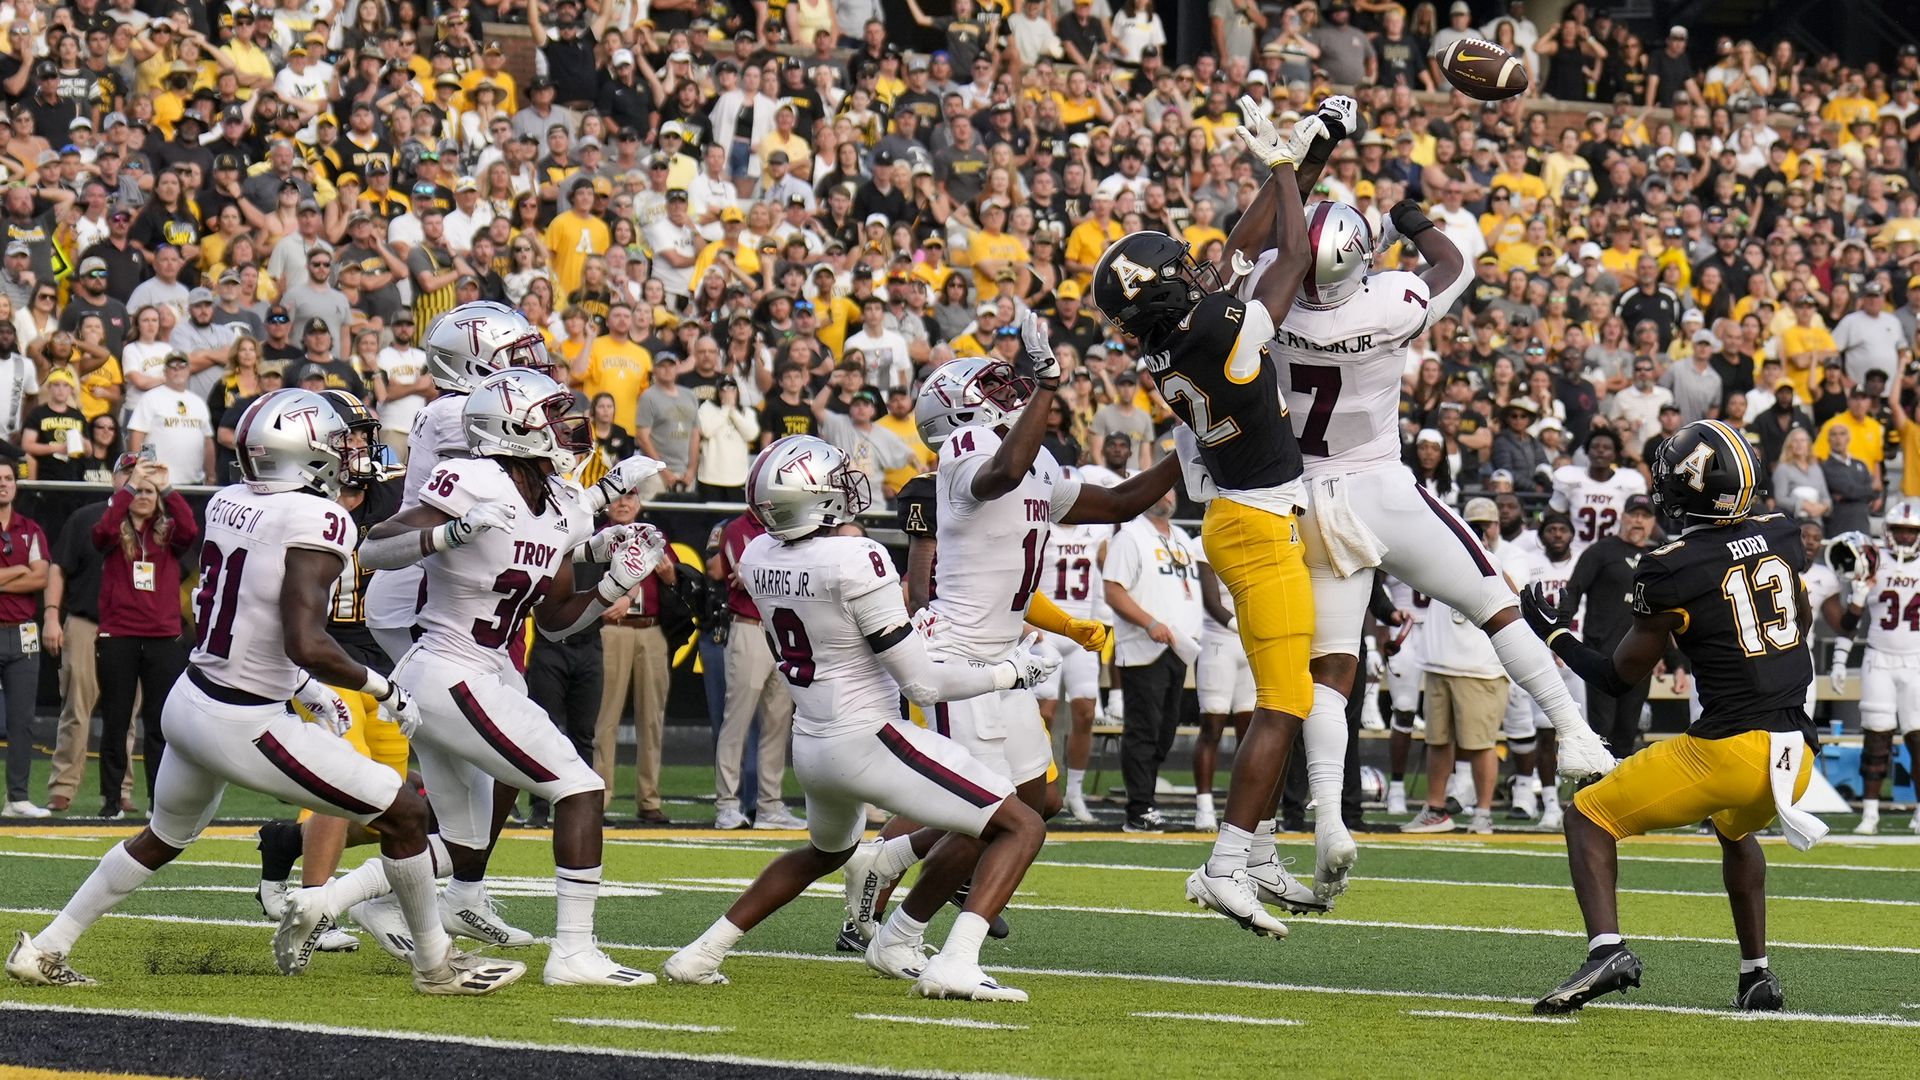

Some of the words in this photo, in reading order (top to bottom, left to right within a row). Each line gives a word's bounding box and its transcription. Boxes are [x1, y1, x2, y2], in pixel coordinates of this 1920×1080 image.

[1329, 100, 1350, 118] adidas
[1403, 288, 1428, 309] 7
[1161, 371, 1242, 447] 2
[1289, 362, 1342, 457] 7
[951, 431, 976, 458] 14
[428, 469, 459, 498] 36
[1585, 494, 1614, 505] TROY
[210, 497, 252, 530] PETTUS
[322, 511, 347, 546] 31
[1579, 507, 1617, 542] 32
[513, 540, 557, 570] TROY
[869, 551, 886, 578] 8
[1056, 544, 1087, 556] TROY
[1726, 534, 1769, 561] HORN
[753, 569, 793, 597] HARRIS
[794, 571, 816, 597] JR.
[1054, 558, 1091, 600] 13
[197, 540, 248, 659] 31
[1721, 554, 1800, 658] 13
[1878, 590, 1920, 632] 34
[772, 607, 816, 689] 8
[859, 870, 878, 923] ADIZERO
[300, 913, 327, 967] ADIZERO
[456, 909, 509, 944] ADIZERO
